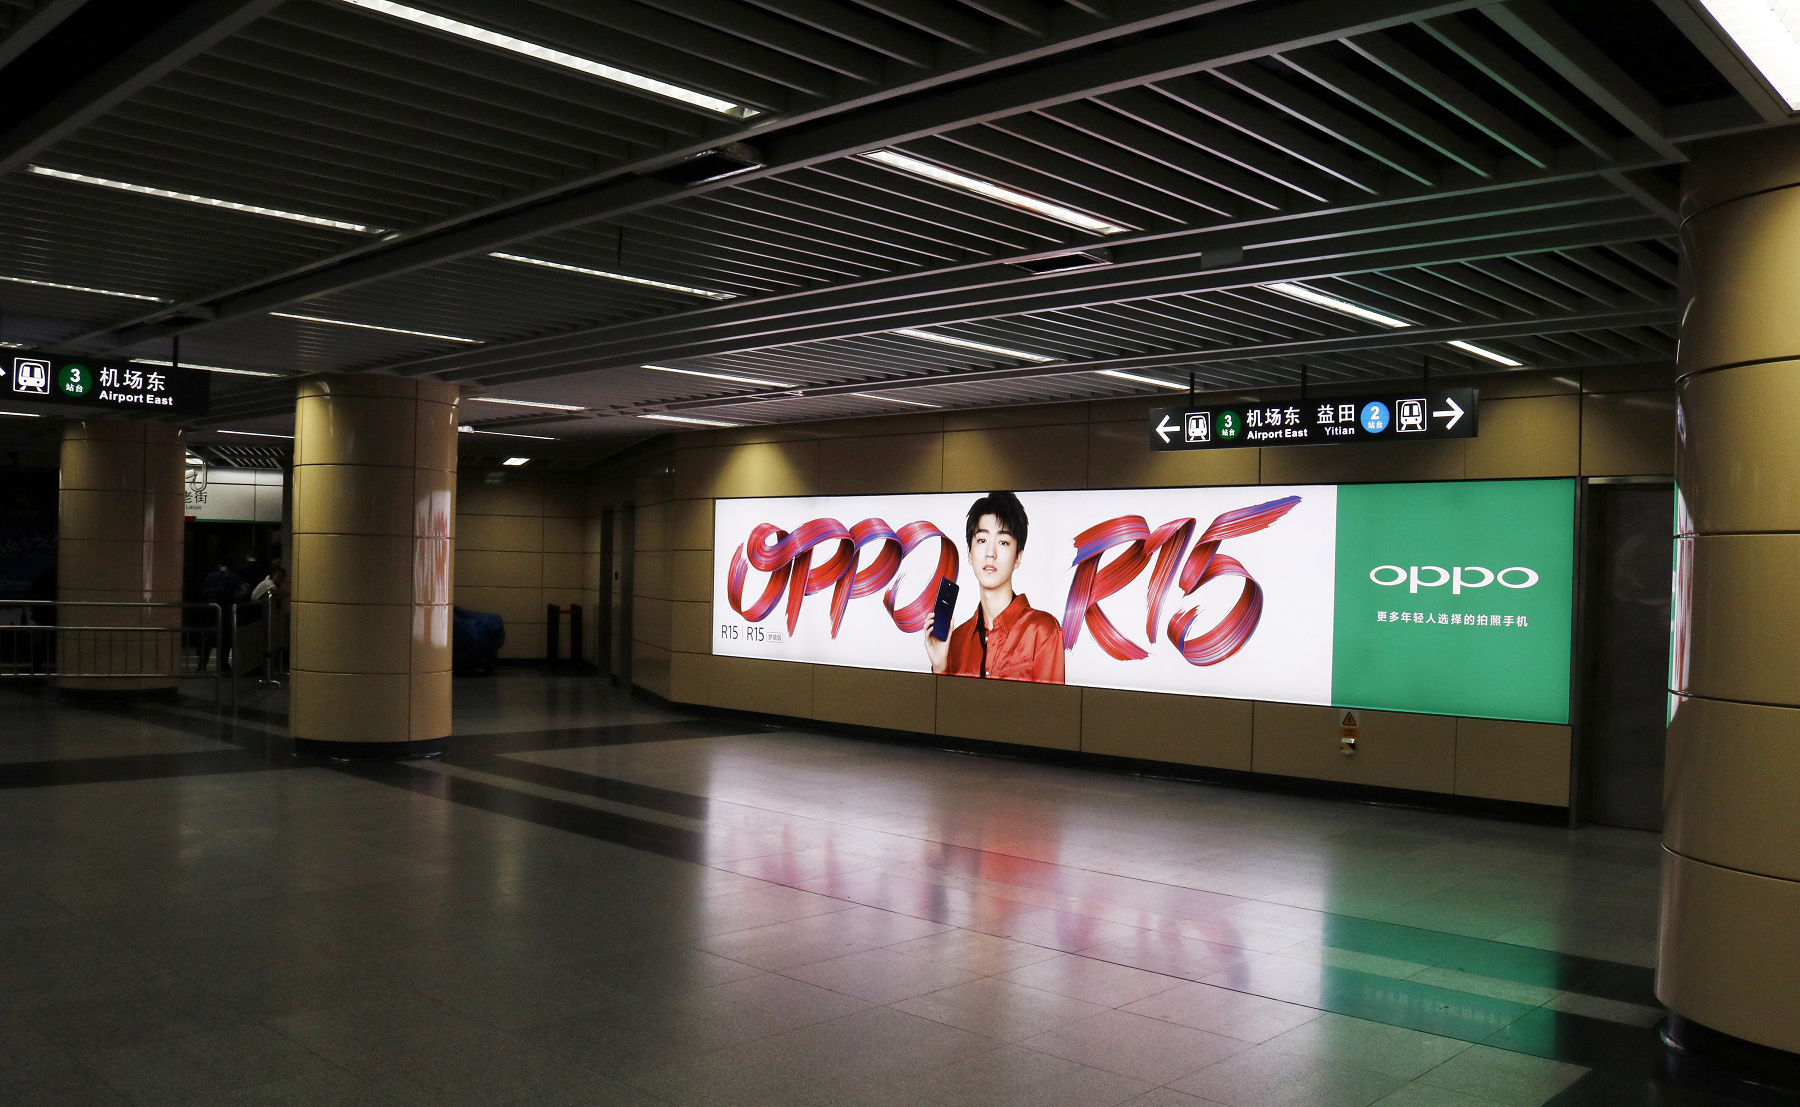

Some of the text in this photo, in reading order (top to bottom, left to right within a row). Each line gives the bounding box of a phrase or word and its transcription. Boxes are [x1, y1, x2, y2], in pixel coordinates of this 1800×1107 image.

[70, 368, 81, 383] 3
[100, 366, 166, 392] 机场东
[65, 383, 84, 393] 站台
[99, 390, 173, 405] Airport East
[1224, 414, 1233, 427] 3
[1246, 404, 1355, 428] 机场东 益田
[1370, 406, 1380, 420] 2
[1222, 428, 1236, 437] 站台
[1367, 420, 1383, 430] 站台
[1247, 426, 1355, 440] Airport East Yitian
[727, 495, 1302, 667] OPPO R15
[1377, 611, 1529, 628] 更多年轻人选择的拍照手机
[721, 624, 739, 640] R15
[746, 626, 765, 642] R15
